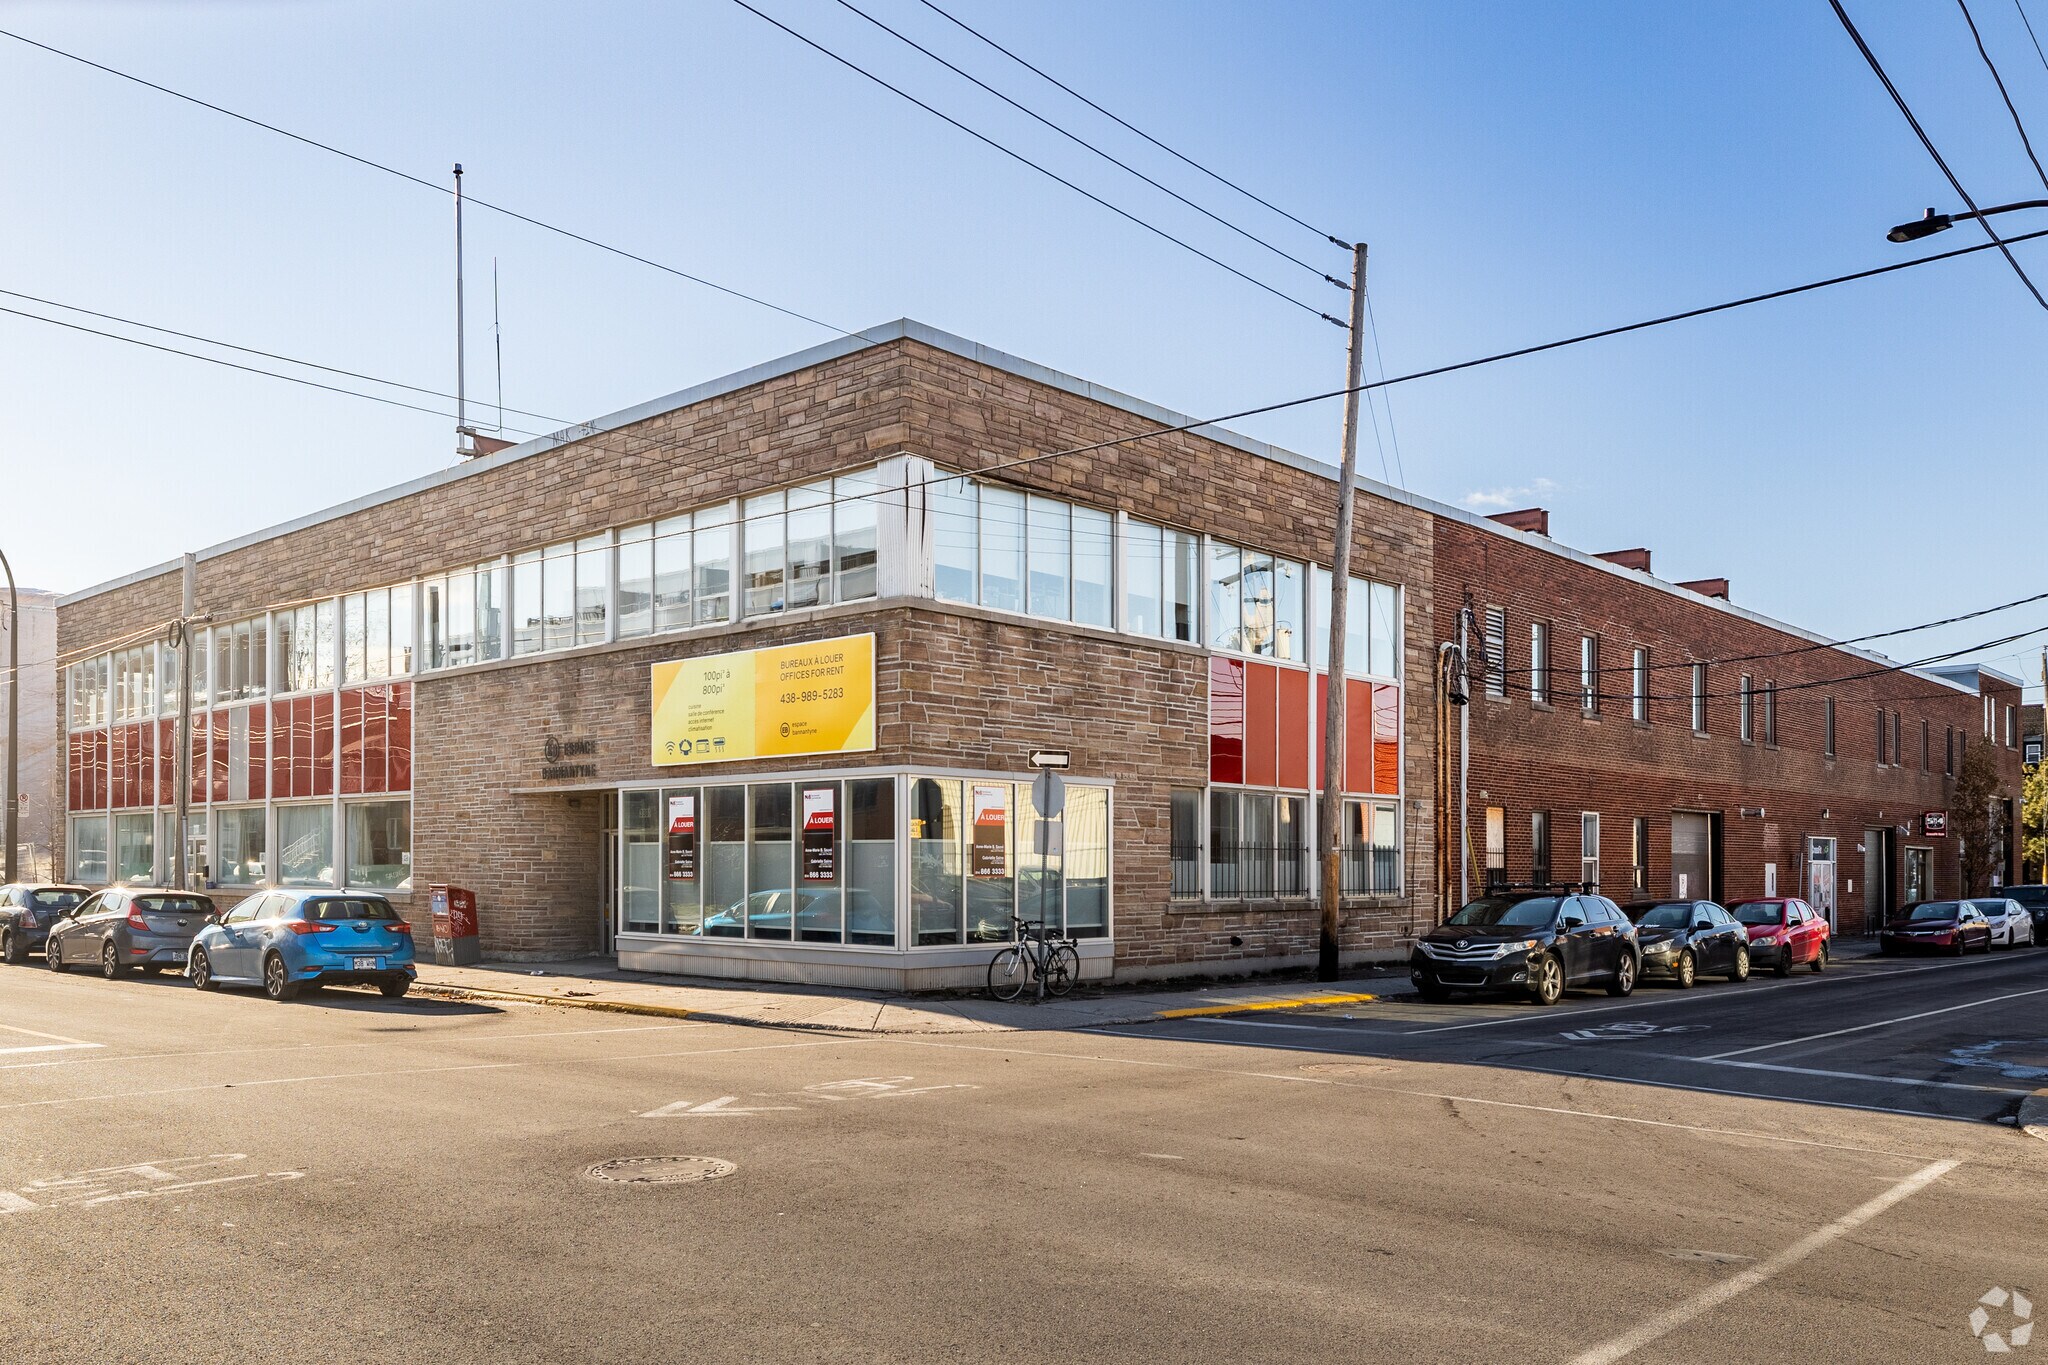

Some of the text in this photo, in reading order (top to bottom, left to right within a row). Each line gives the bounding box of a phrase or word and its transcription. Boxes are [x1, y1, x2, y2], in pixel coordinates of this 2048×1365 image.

[780, 654, 844, 670] BUREAUX À LOUER
[726, 669, 730, 678] à
[780, 666, 844, 682] OFFICES FOR RENT
[780, 687, 844, 704] 438-989-5283
[564, 741, 596, 756] ESPACE
